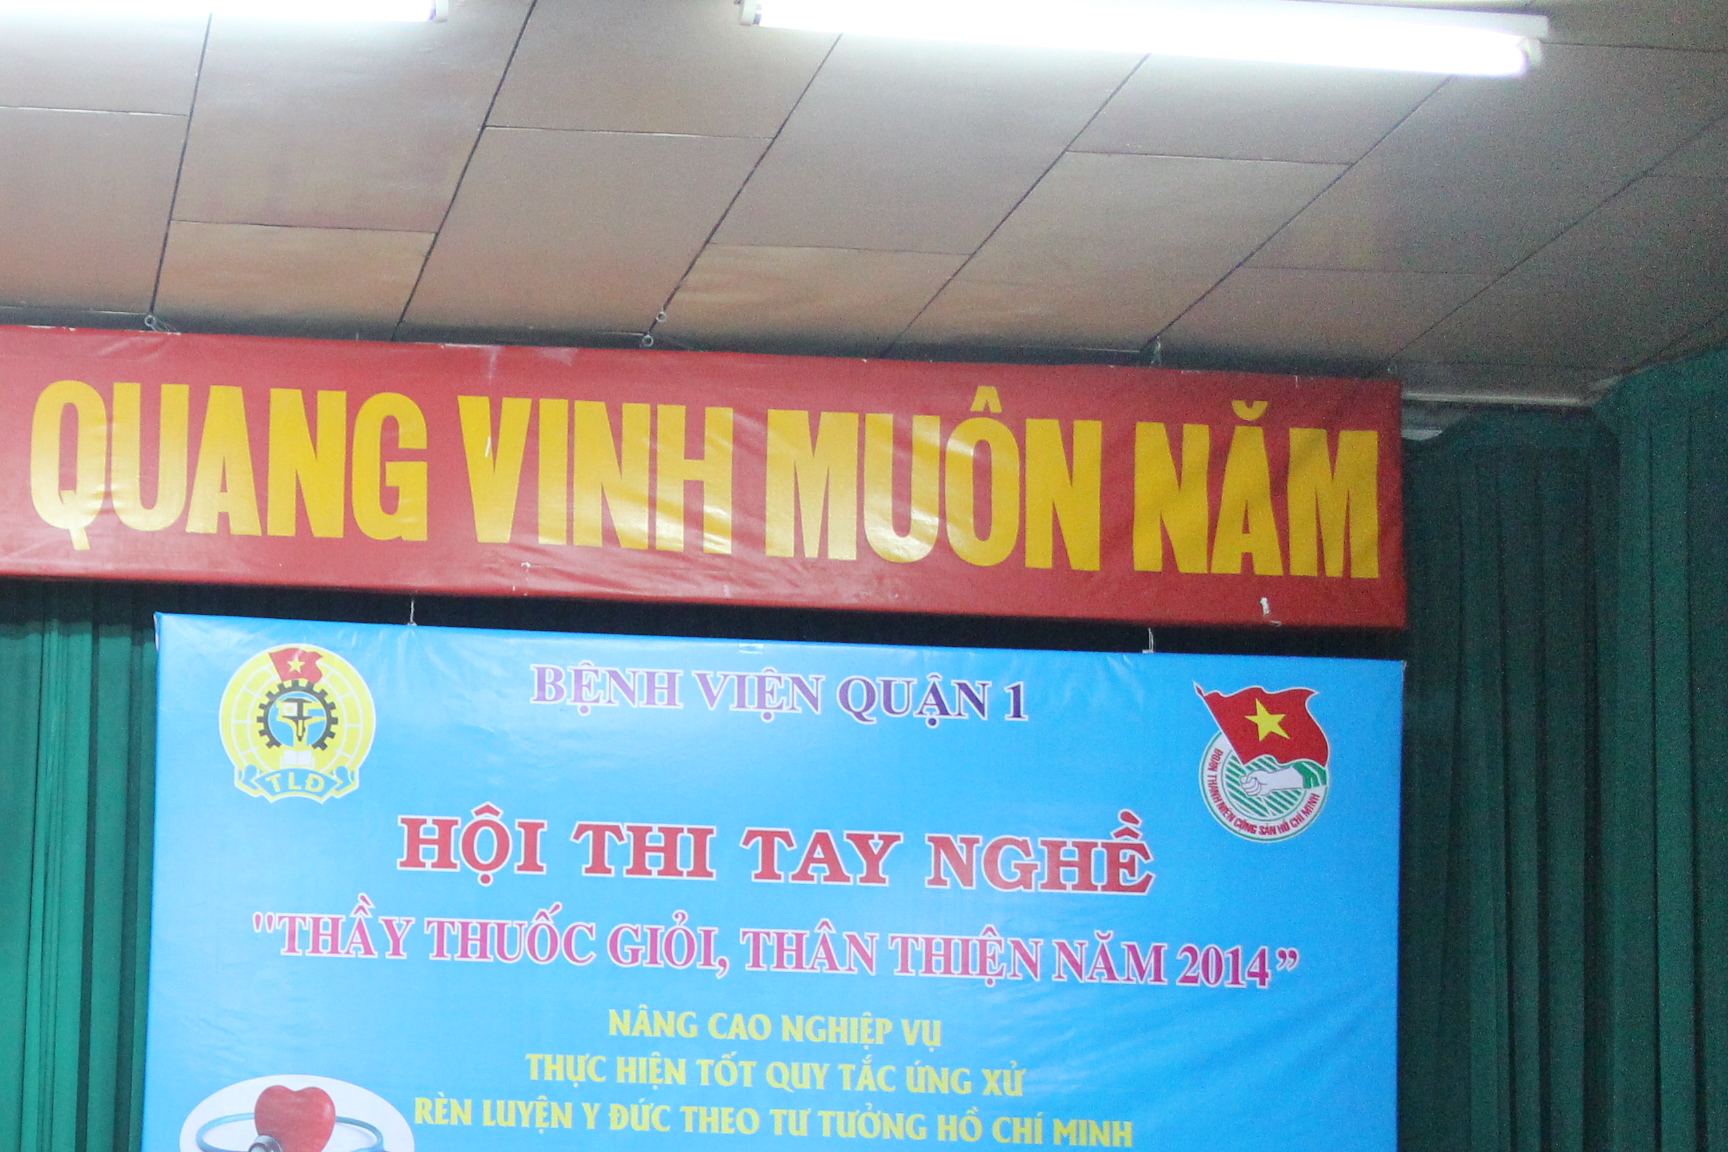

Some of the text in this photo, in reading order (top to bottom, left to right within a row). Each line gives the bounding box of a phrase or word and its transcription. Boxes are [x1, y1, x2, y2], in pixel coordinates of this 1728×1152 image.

[31, 380, 428, 551] QUANG
[457, 395, 734, 554] VINH
[766, 385, 1102, 571] MUÔN
[1132, 399, 1378, 579] NĂM
[530, 661, 1028, 728] BỆNH VIỆN QUẬN 1
[265, 772, 325, 793] TLĐ
[1207, 775, 1222, 803] THANH
[1301, 793, 1320, 817] MINH
[397, 801, 1155, 896] HỘI THI TAY NGHỀ
[424, 903, 596, 965] THUỐC
[607, 911, 729, 980] GIỎI,
[740, 919, 877, 976] THÂN
[890, 925, 1042, 987] THIỆN
[1053, 931, 1169, 985] NĂM
[608, 1004, 942, 1053] NÂNG CAO NGHIỆP VỤ
[525, 1051, 1026, 1097] THỰC HIỆN TỐT QUY TẮC ỨNG XỬ
[414, 1090, 1134, 1148] RÈN LUYỆN Y ĐỨC THEO TƯ TƯỞNG HỒ CHÍ MINH
